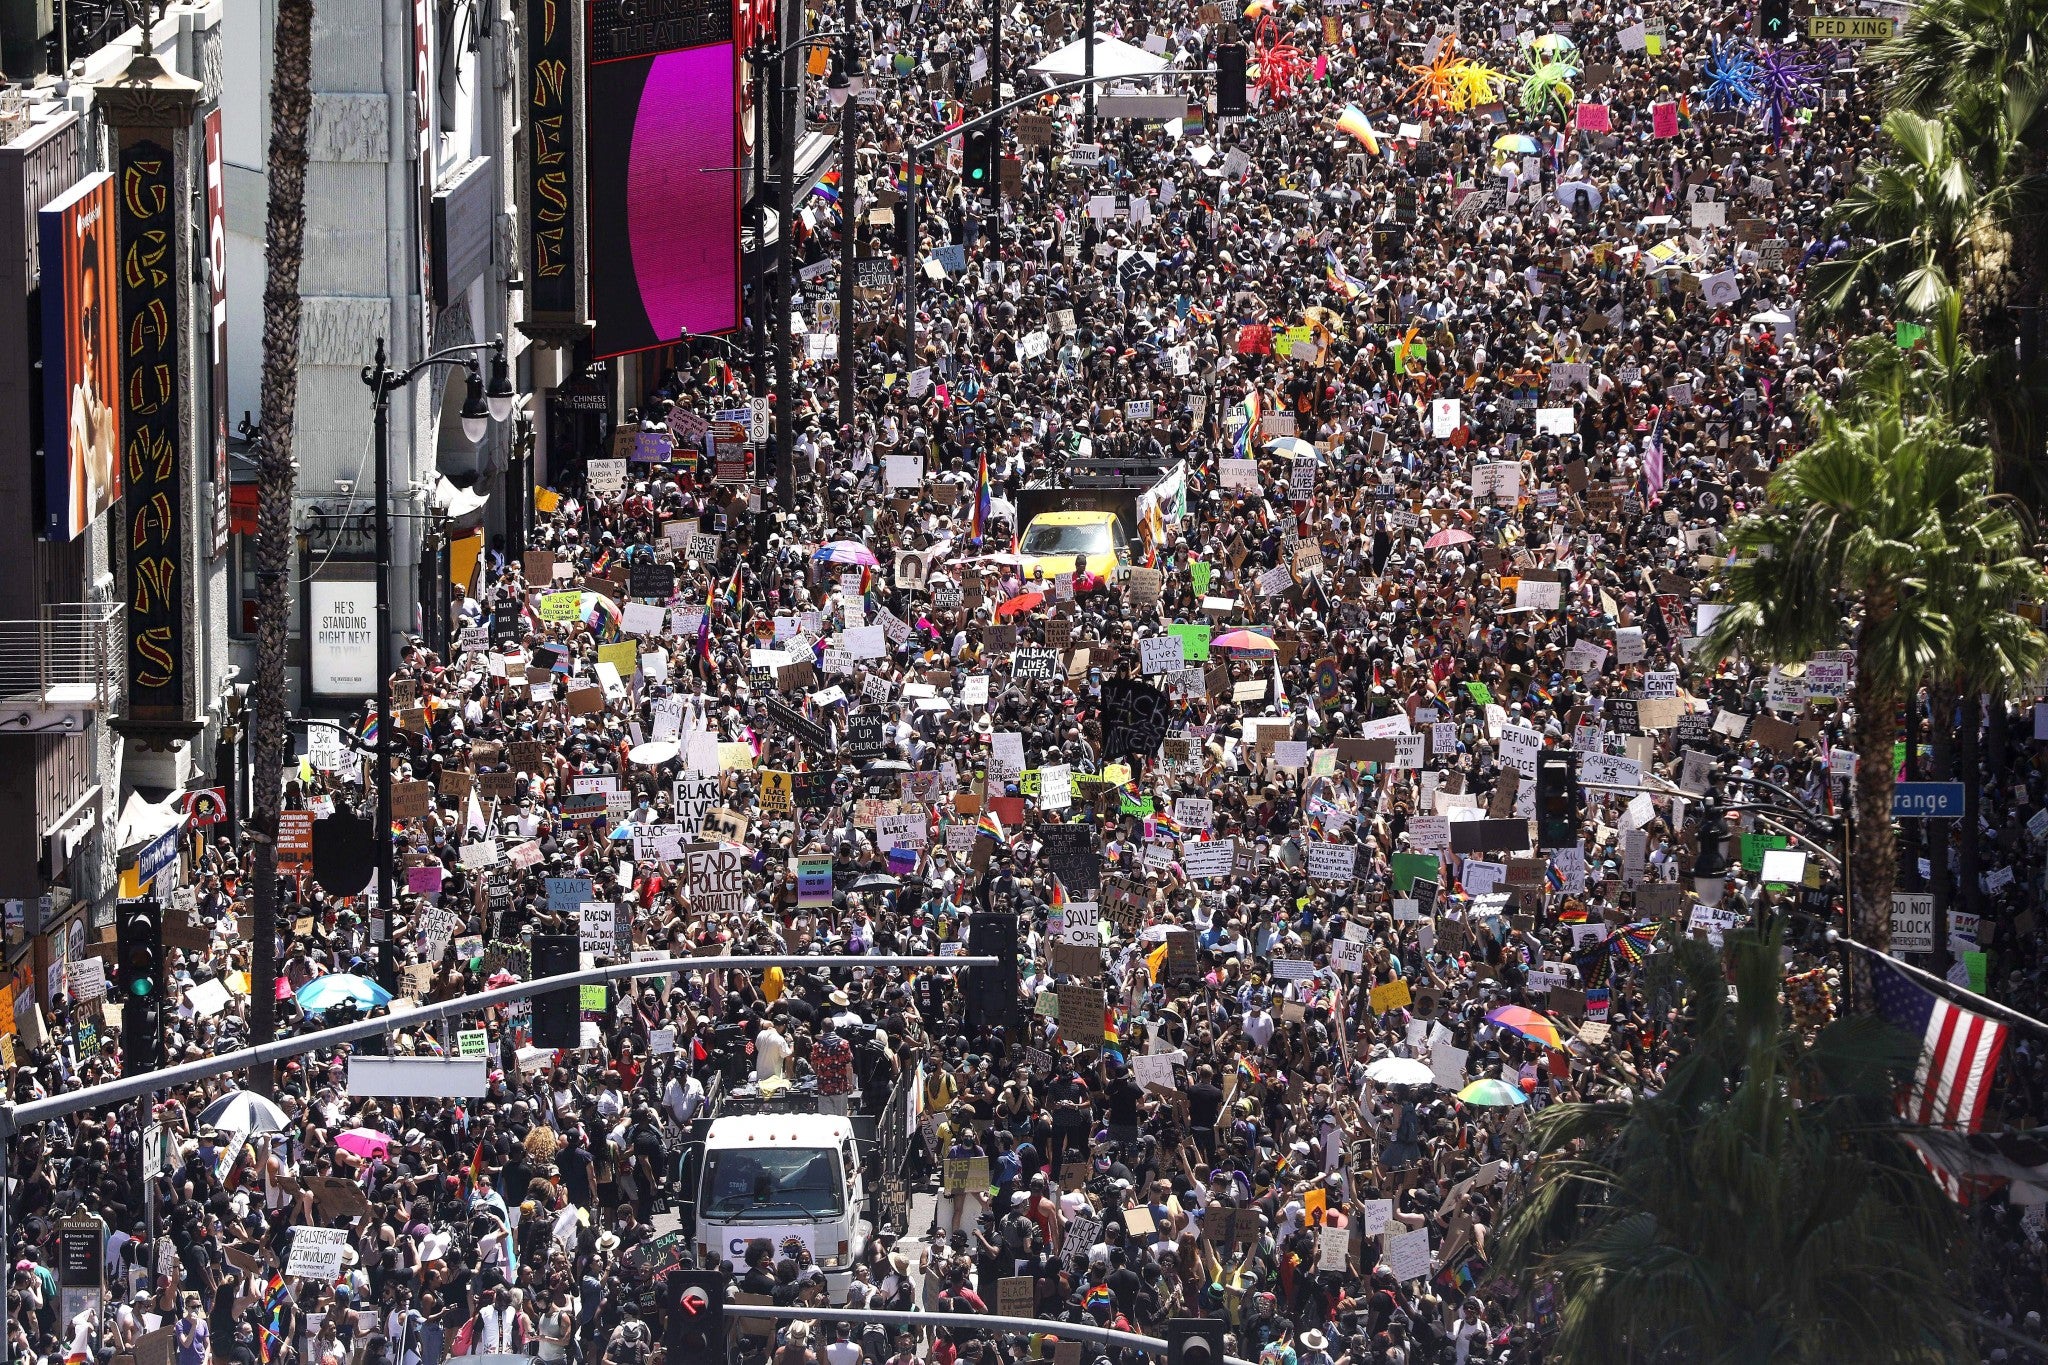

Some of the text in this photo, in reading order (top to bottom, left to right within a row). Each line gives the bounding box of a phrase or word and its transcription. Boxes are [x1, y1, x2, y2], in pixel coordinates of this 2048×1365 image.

[610, 13, 719, 52] THEATRES
[1814, 21, 1887, 36] PED XING
[1071, 150, 1096, 160] JUSTICE
[859, 263, 891, 274] BLACK
[613, 461, 626, 469] YOU
[1295, 459, 1315, 468] BLACK
[1289, 488, 1313, 499] MATTER
[1375, 485, 1395, 495] BLM
[692, 536, 717, 546] BLACK
[1294, 540, 1317, 552] BLACK
[690, 543, 714, 552] LIVES
[687, 551, 716, 560] MATTER
[332, 601, 354, 614] HE'S
[322, 615, 367, 633] STANDING
[318, 631, 371, 645] RIGHT NEXT
[464, 630, 479, 641] NOT
[1142, 637, 1182, 651] BLACK
[1016, 649, 1056, 659] ALL BLACK
[1148, 650, 1178, 660] Lives
[1021, 659, 1048, 669] LIVES
[1144, 658, 1182, 673] MATTER
[1016, 668, 1051, 678] MATTER
[866, 681, 887, 693] BLACK
[870, 676, 883, 686] ALL
[1647, 681, 1674, 691] CANT
[865, 689, 887, 701] LIVES
[1615, 702, 1633, 710] NO
[849, 714, 882, 729] SPEAK
[1501, 730, 1540, 748] DEFUND
[1603, 735, 1622, 745] BLM
[1511, 746, 1525, 755] THE
[309, 750, 340, 768] CRIME
[1500, 755, 1536, 772] POLICE
[1584, 758, 1639, 777] TRANSPHOBIA
[1603, 767, 1617, 777] IS
[794, 775, 828, 789] BLACK
[678, 781, 720, 800] BLACK
[766, 787, 787, 796] BLACK
[765, 795, 786, 803] LIVES
[1893, 793, 1949, 812] range
[763, 803, 788, 811] MATTER
[633, 825, 668, 837] BLACK
[702, 813, 738, 838] BLM
[882, 825, 909, 835] BLACK
[1193, 841, 1211, 849] BLACK
[689, 850, 737, 871] END
[489, 874, 509, 885] BLACK
[690, 871, 742, 893] POLICE
[490, 886, 509, 897] LIVES
[554, 882, 590, 895] BLACK
[1110, 877, 1150, 900] BLACK
[489, 897, 511, 909] MATTER
[689, 892, 743, 914] BRUTALITY
[1104, 896, 1144, 917] LIVES
[1892, 902, 1932, 914] DO NOT
[427, 908, 454, 924] BLACK
[584, 910, 611, 923] RACISM
[1064, 909, 1098, 929] SAVE
[1099, 907, 1143, 929] MATTER
[1892, 920, 1932, 934] BLOCK
[600, 931, 613, 939] DICK
[1072, 931, 1095, 941] OUR
[583, 940, 610, 955] ENERGY
[1345, 943, 1364, 954] BLACK
[1338, 951, 1357, 961] LIVES
[79, 1019, 92, 1029] ALL
[78, 1025, 97, 1041] BLACK
[79, 1035, 98, 1049] LIVES
[1368, 1208, 1389, 1217] JUSTICE
[1069, 1221, 1099, 1241] WHERE
[294, 1230, 328, 1246] REGISTER
[656, 1233, 678, 1248] BLACK
[291, 1250, 337, 1264] GET INVOLVED!
